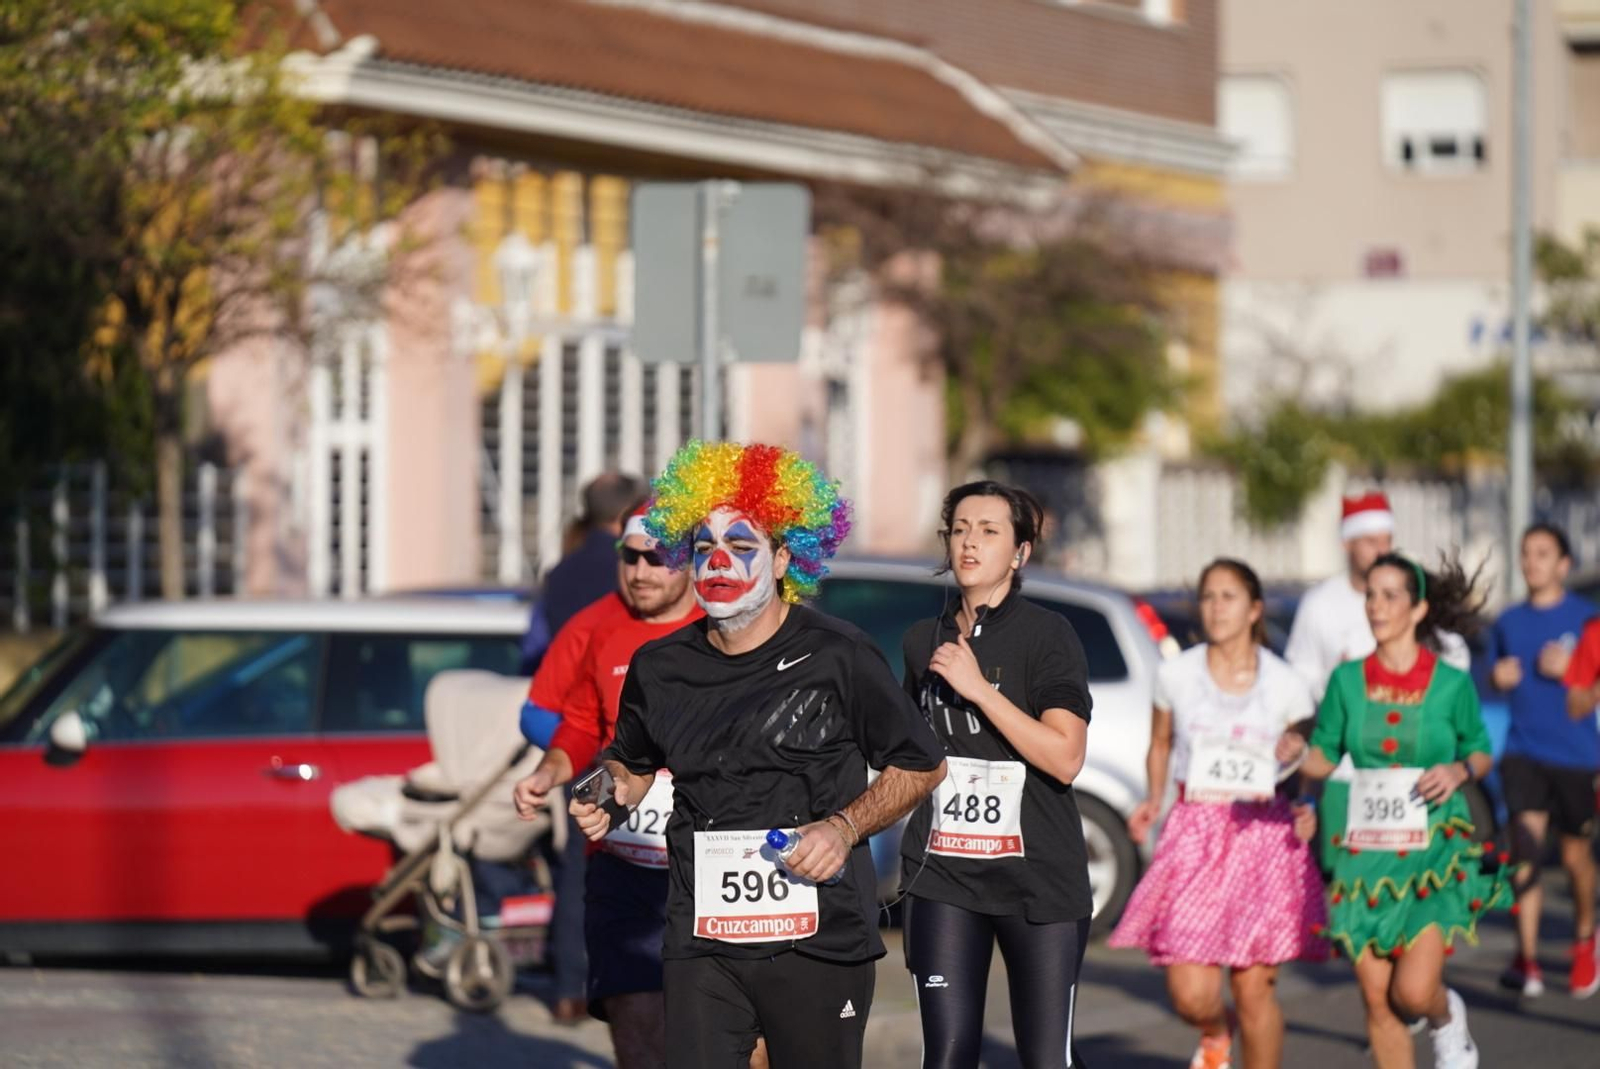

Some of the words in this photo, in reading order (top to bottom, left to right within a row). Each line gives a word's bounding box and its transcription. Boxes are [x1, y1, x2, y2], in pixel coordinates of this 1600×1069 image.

[1207, 758, 1255, 783] 432
[942, 792, 1001, 825] 488
[1363, 796, 1406, 822] 398
[932, 831, 1003, 854] Cruzcampo
[721, 870, 790, 904] 596
[706, 917, 795, 936] Cruzcampo
[840, 1010, 856, 1019] adidas
